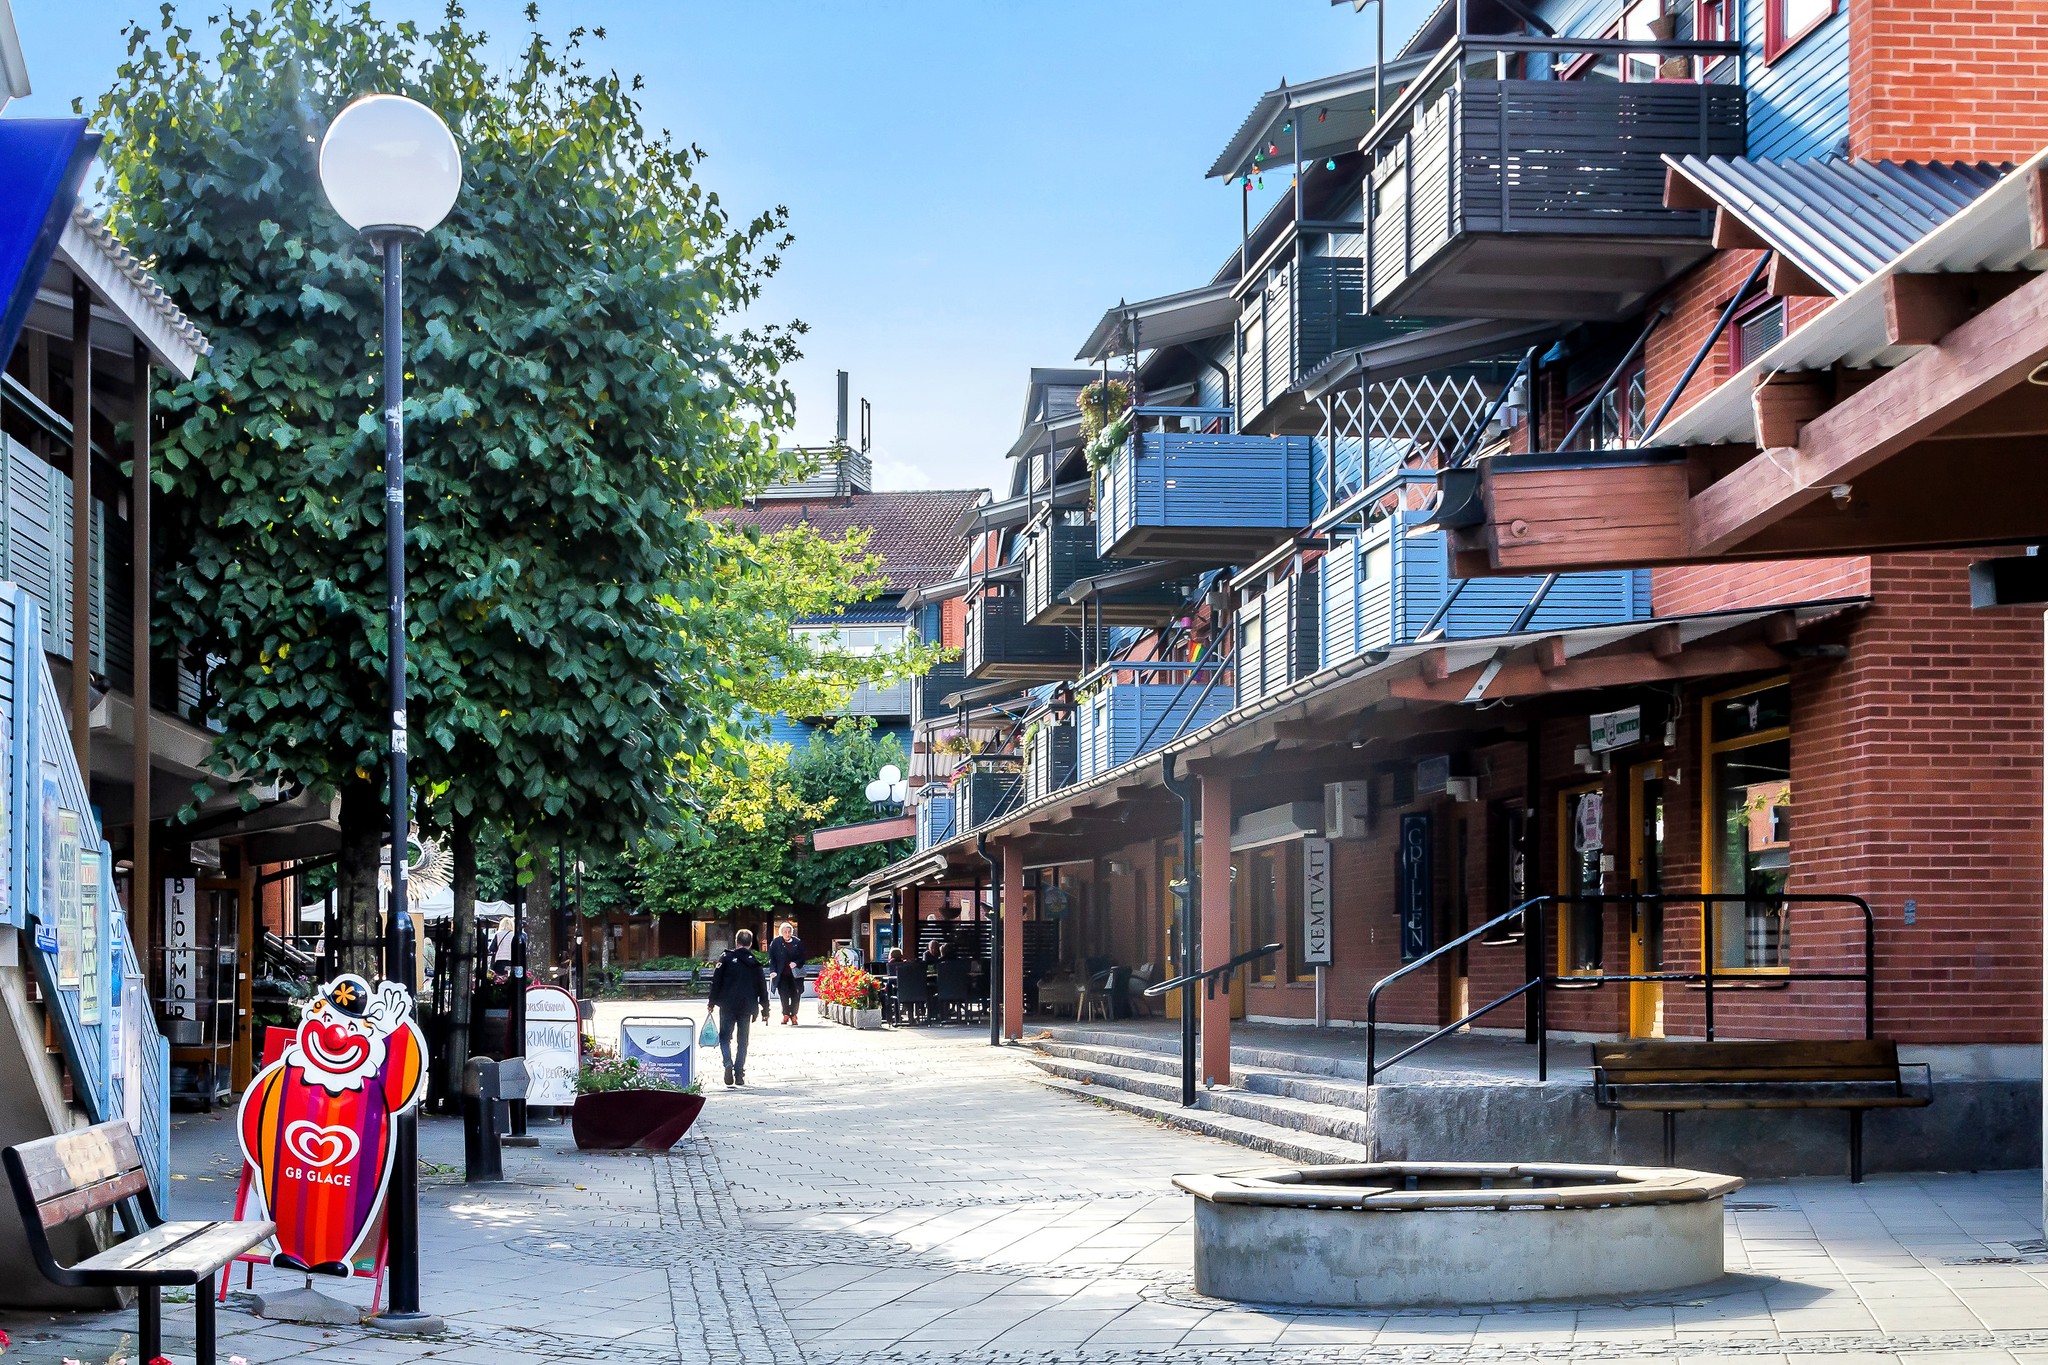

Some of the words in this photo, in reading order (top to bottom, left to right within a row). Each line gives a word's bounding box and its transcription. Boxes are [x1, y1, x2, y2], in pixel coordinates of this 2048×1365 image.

[1308, 846, 1325, 956] KEMTVÄTT
[1408, 828, 1423, 947] GRILLEN
[526, 1024, 576, 1053] RUKVÄXTER
[661, 1039, 681, 1047] ItCare
[285, 1166, 302, 1180] GB
[306, 1170, 352, 1187] GLACE
